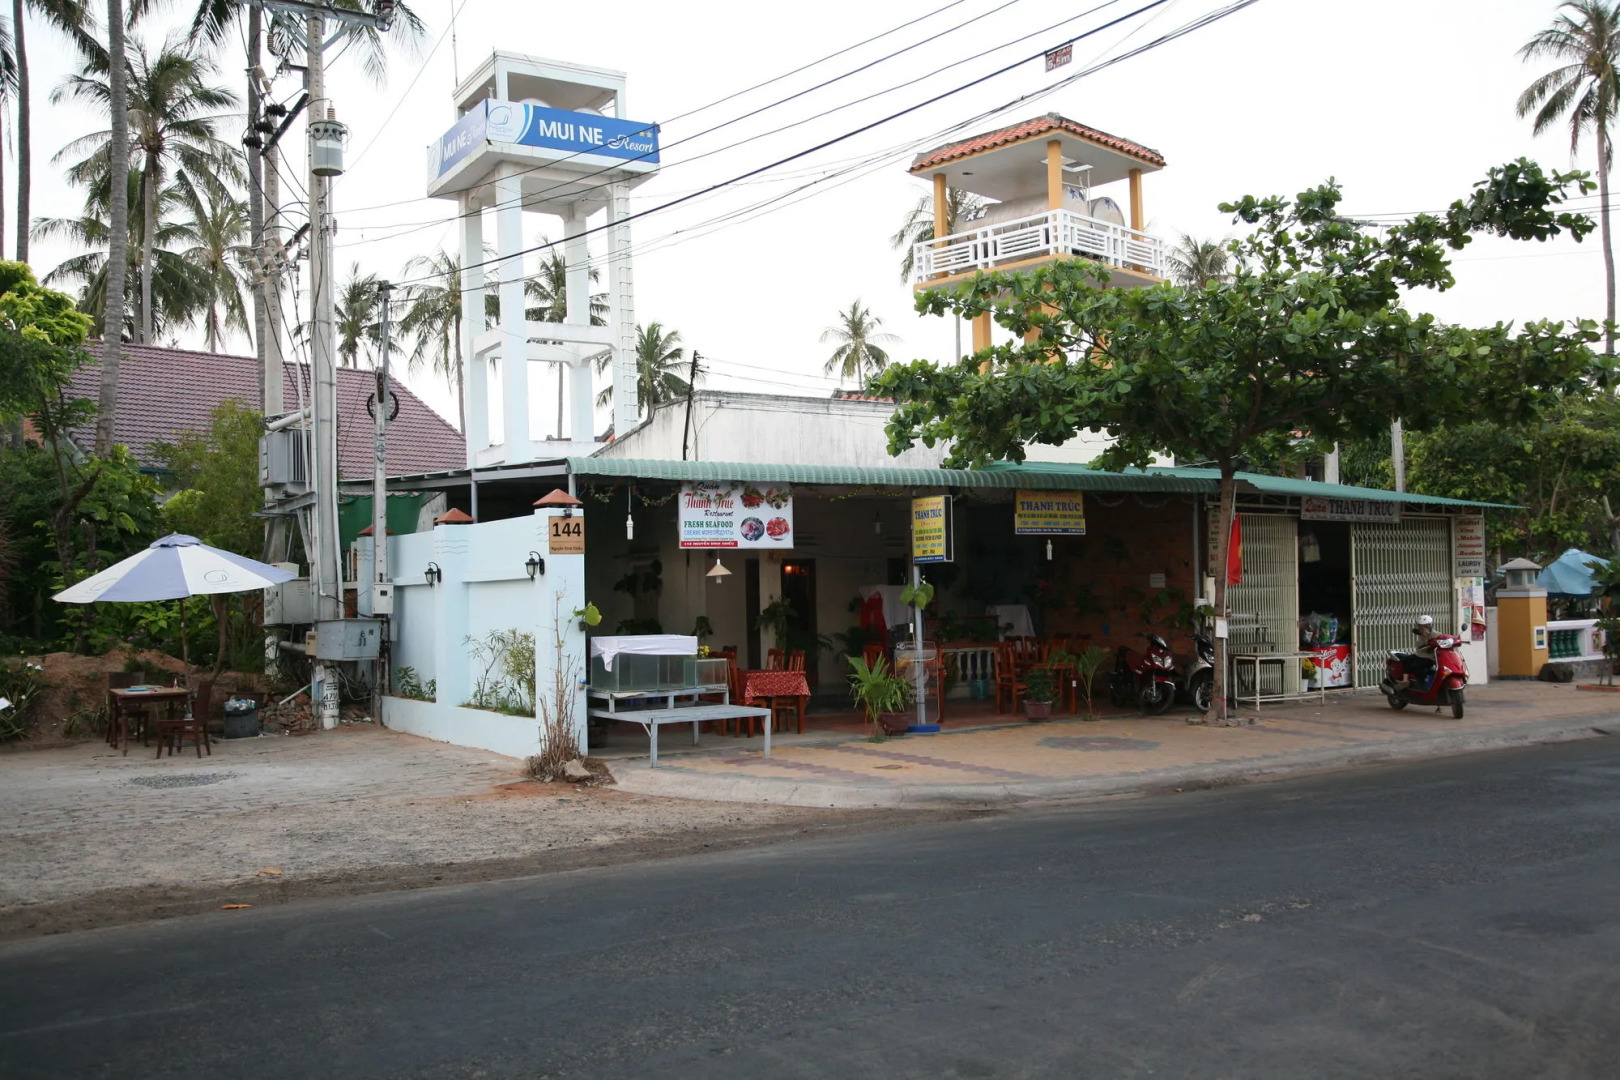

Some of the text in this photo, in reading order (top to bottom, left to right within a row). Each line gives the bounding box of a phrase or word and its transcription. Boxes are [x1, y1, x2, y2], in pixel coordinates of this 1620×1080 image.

[539, 119, 575, 141] MUI
[580, 127, 604, 146] NE
[609, 133, 654, 154] Resort
[443, 138, 457, 162] MUI
[697, 482, 720, 492] Quán
[1019, 500, 1054, 511] THANH
[1329, 499, 1364, 515] THANH
[704, 509, 734, 517] Restaurant
[915, 510, 929, 520] THANH
[552, 522, 582, 537] 144
[684, 520, 734, 528] FRESH SEAFOOD
